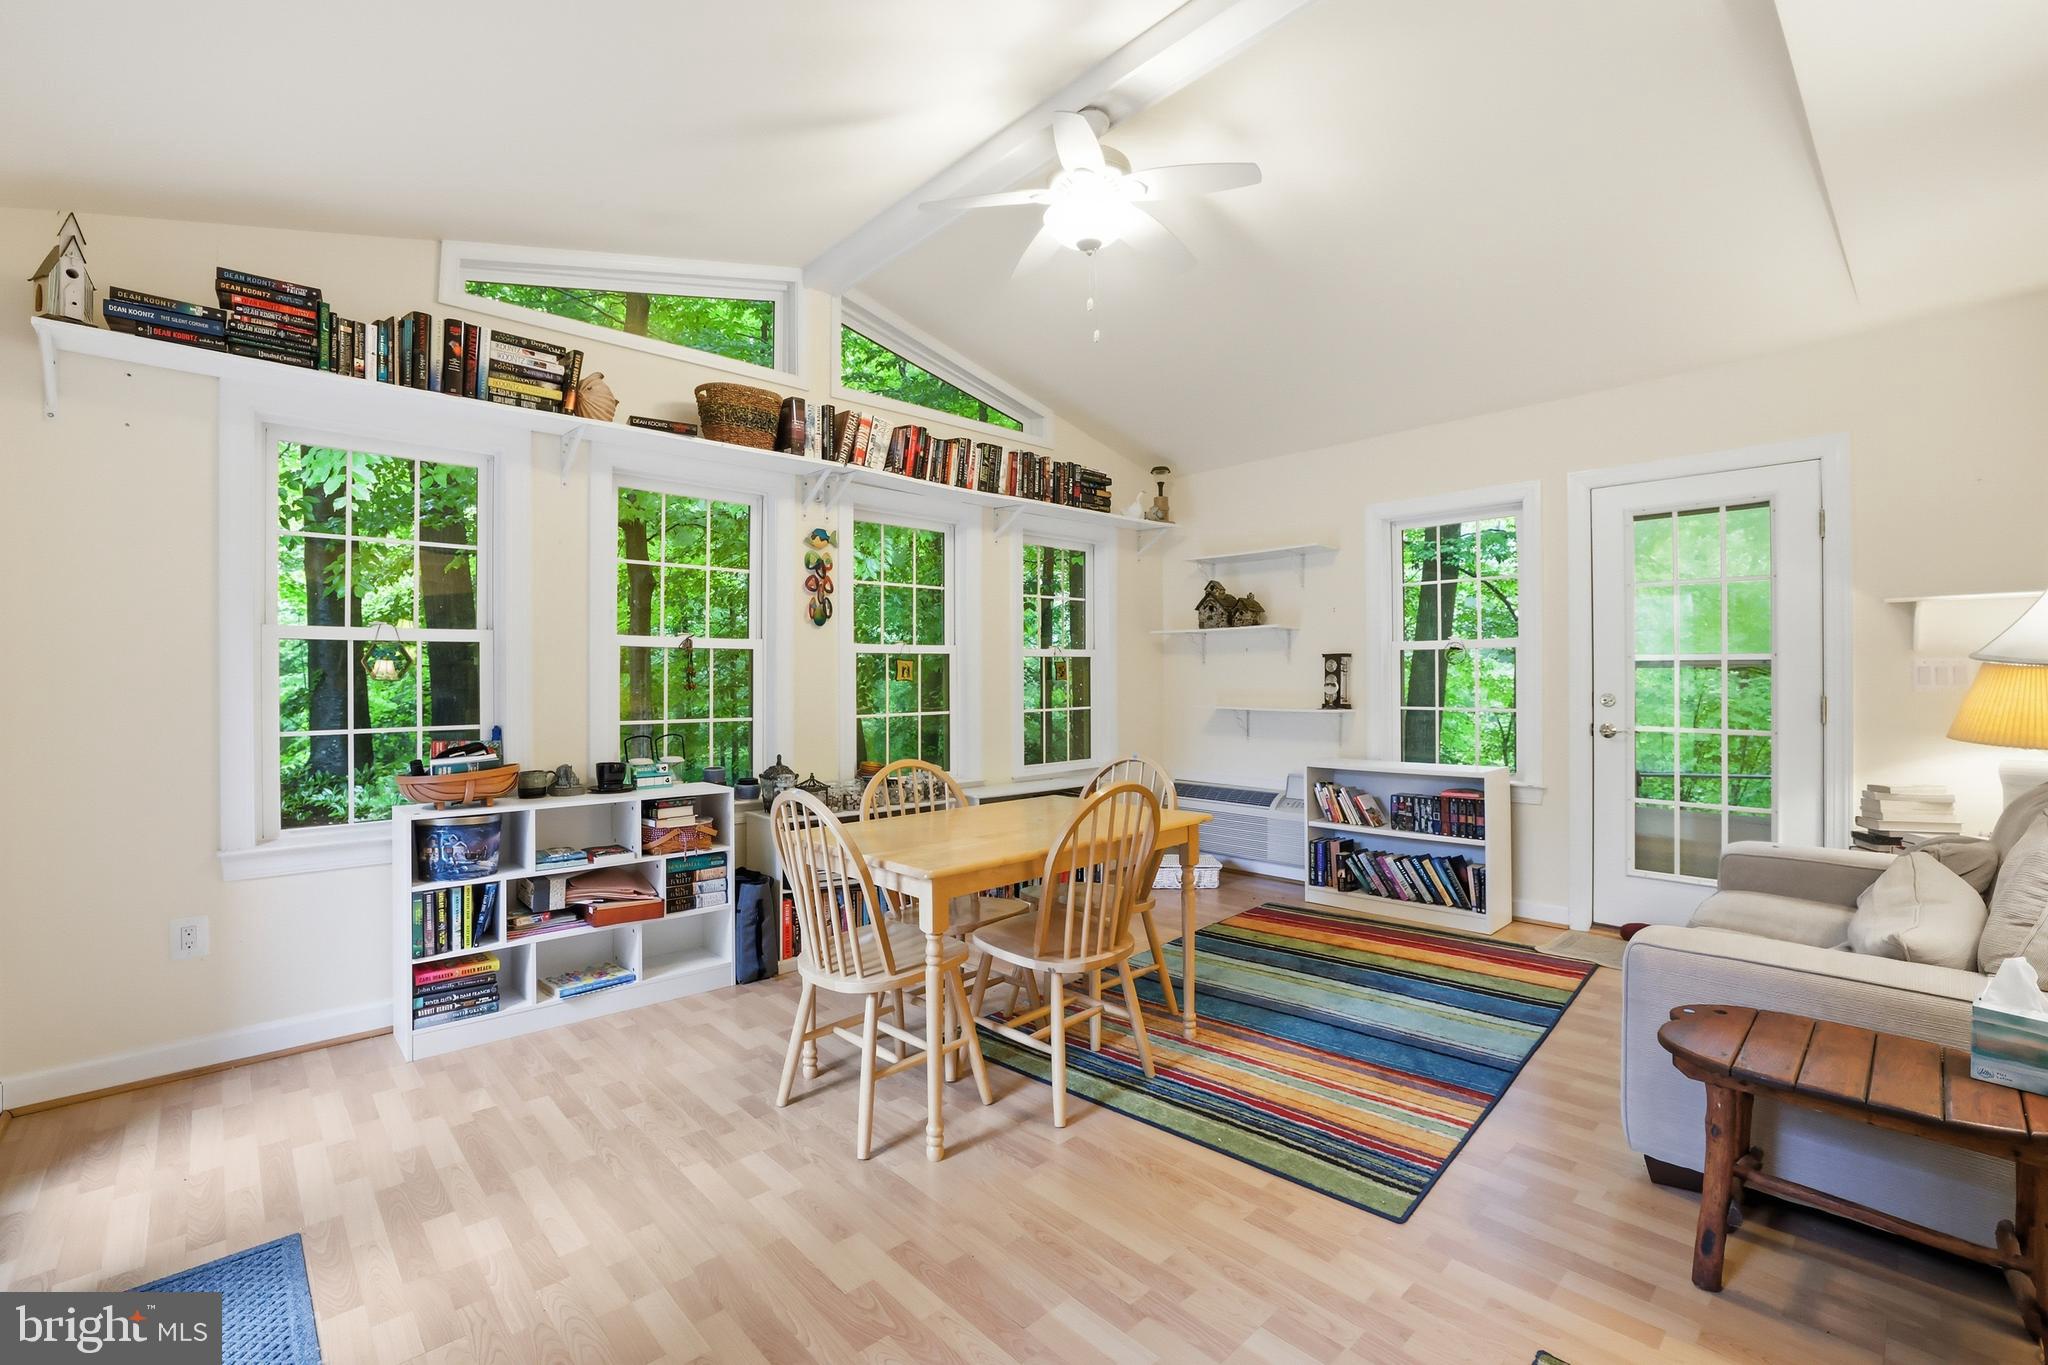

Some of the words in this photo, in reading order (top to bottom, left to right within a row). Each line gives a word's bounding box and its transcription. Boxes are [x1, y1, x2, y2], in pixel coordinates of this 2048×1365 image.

[223, 271, 245, 281] DEAN
[246, 275, 276, 287] KOONTZ
[220, 282, 241, 291] DEAN
[242, 287, 270, 297] KOONTZ
[117, 290, 141, 301] DEAN
[143, 297, 176, 308] KOONTZ
[108, 304, 127, 312] DEAN
[128, 308, 155, 318] KOONTZ
[242, 307, 259, 315] DEAN
[259, 310, 281, 320] KOONTZ
[152, 327, 171, 337] DEAN
[172, 331, 198, 342] KOONTZ
[236, 323, 253, 331] DEAN
[253, 326, 276, 336] KOONTZ
[843, 411, 856, 446] STEPHEN
[839, 445, 851, 463] KING
[432, 972, 453, 980] HIAASEN
[416, 986, 430, 994] John
[431, 982, 454, 992] Connolly
[471, 988, 490, 996] FRANCIS
